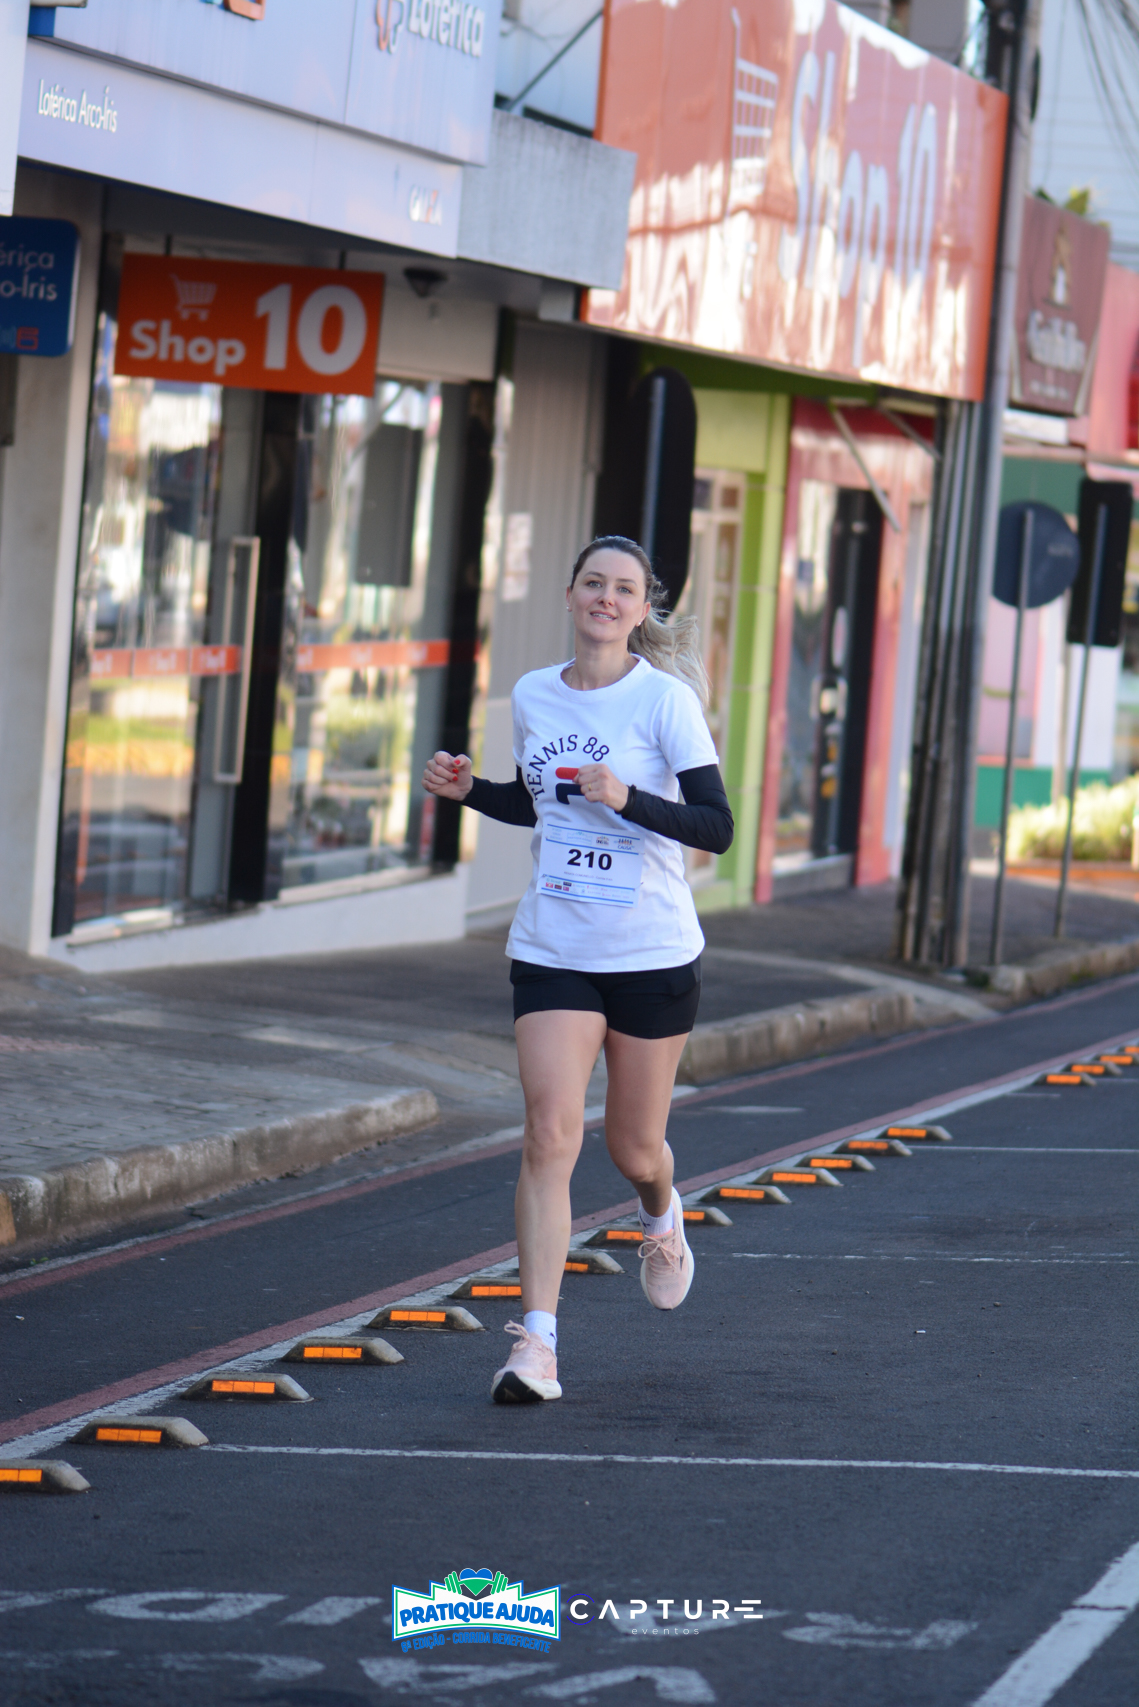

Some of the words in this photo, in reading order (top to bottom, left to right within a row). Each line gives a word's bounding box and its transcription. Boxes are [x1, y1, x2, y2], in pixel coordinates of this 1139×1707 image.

[129, 319, 246, 376] Shop
[255, 283, 368, 376] 10
[527, 734, 578, 801] TENNIS
[583, 736, 610, 762] 88
[567, 848, 613, 871] 210
